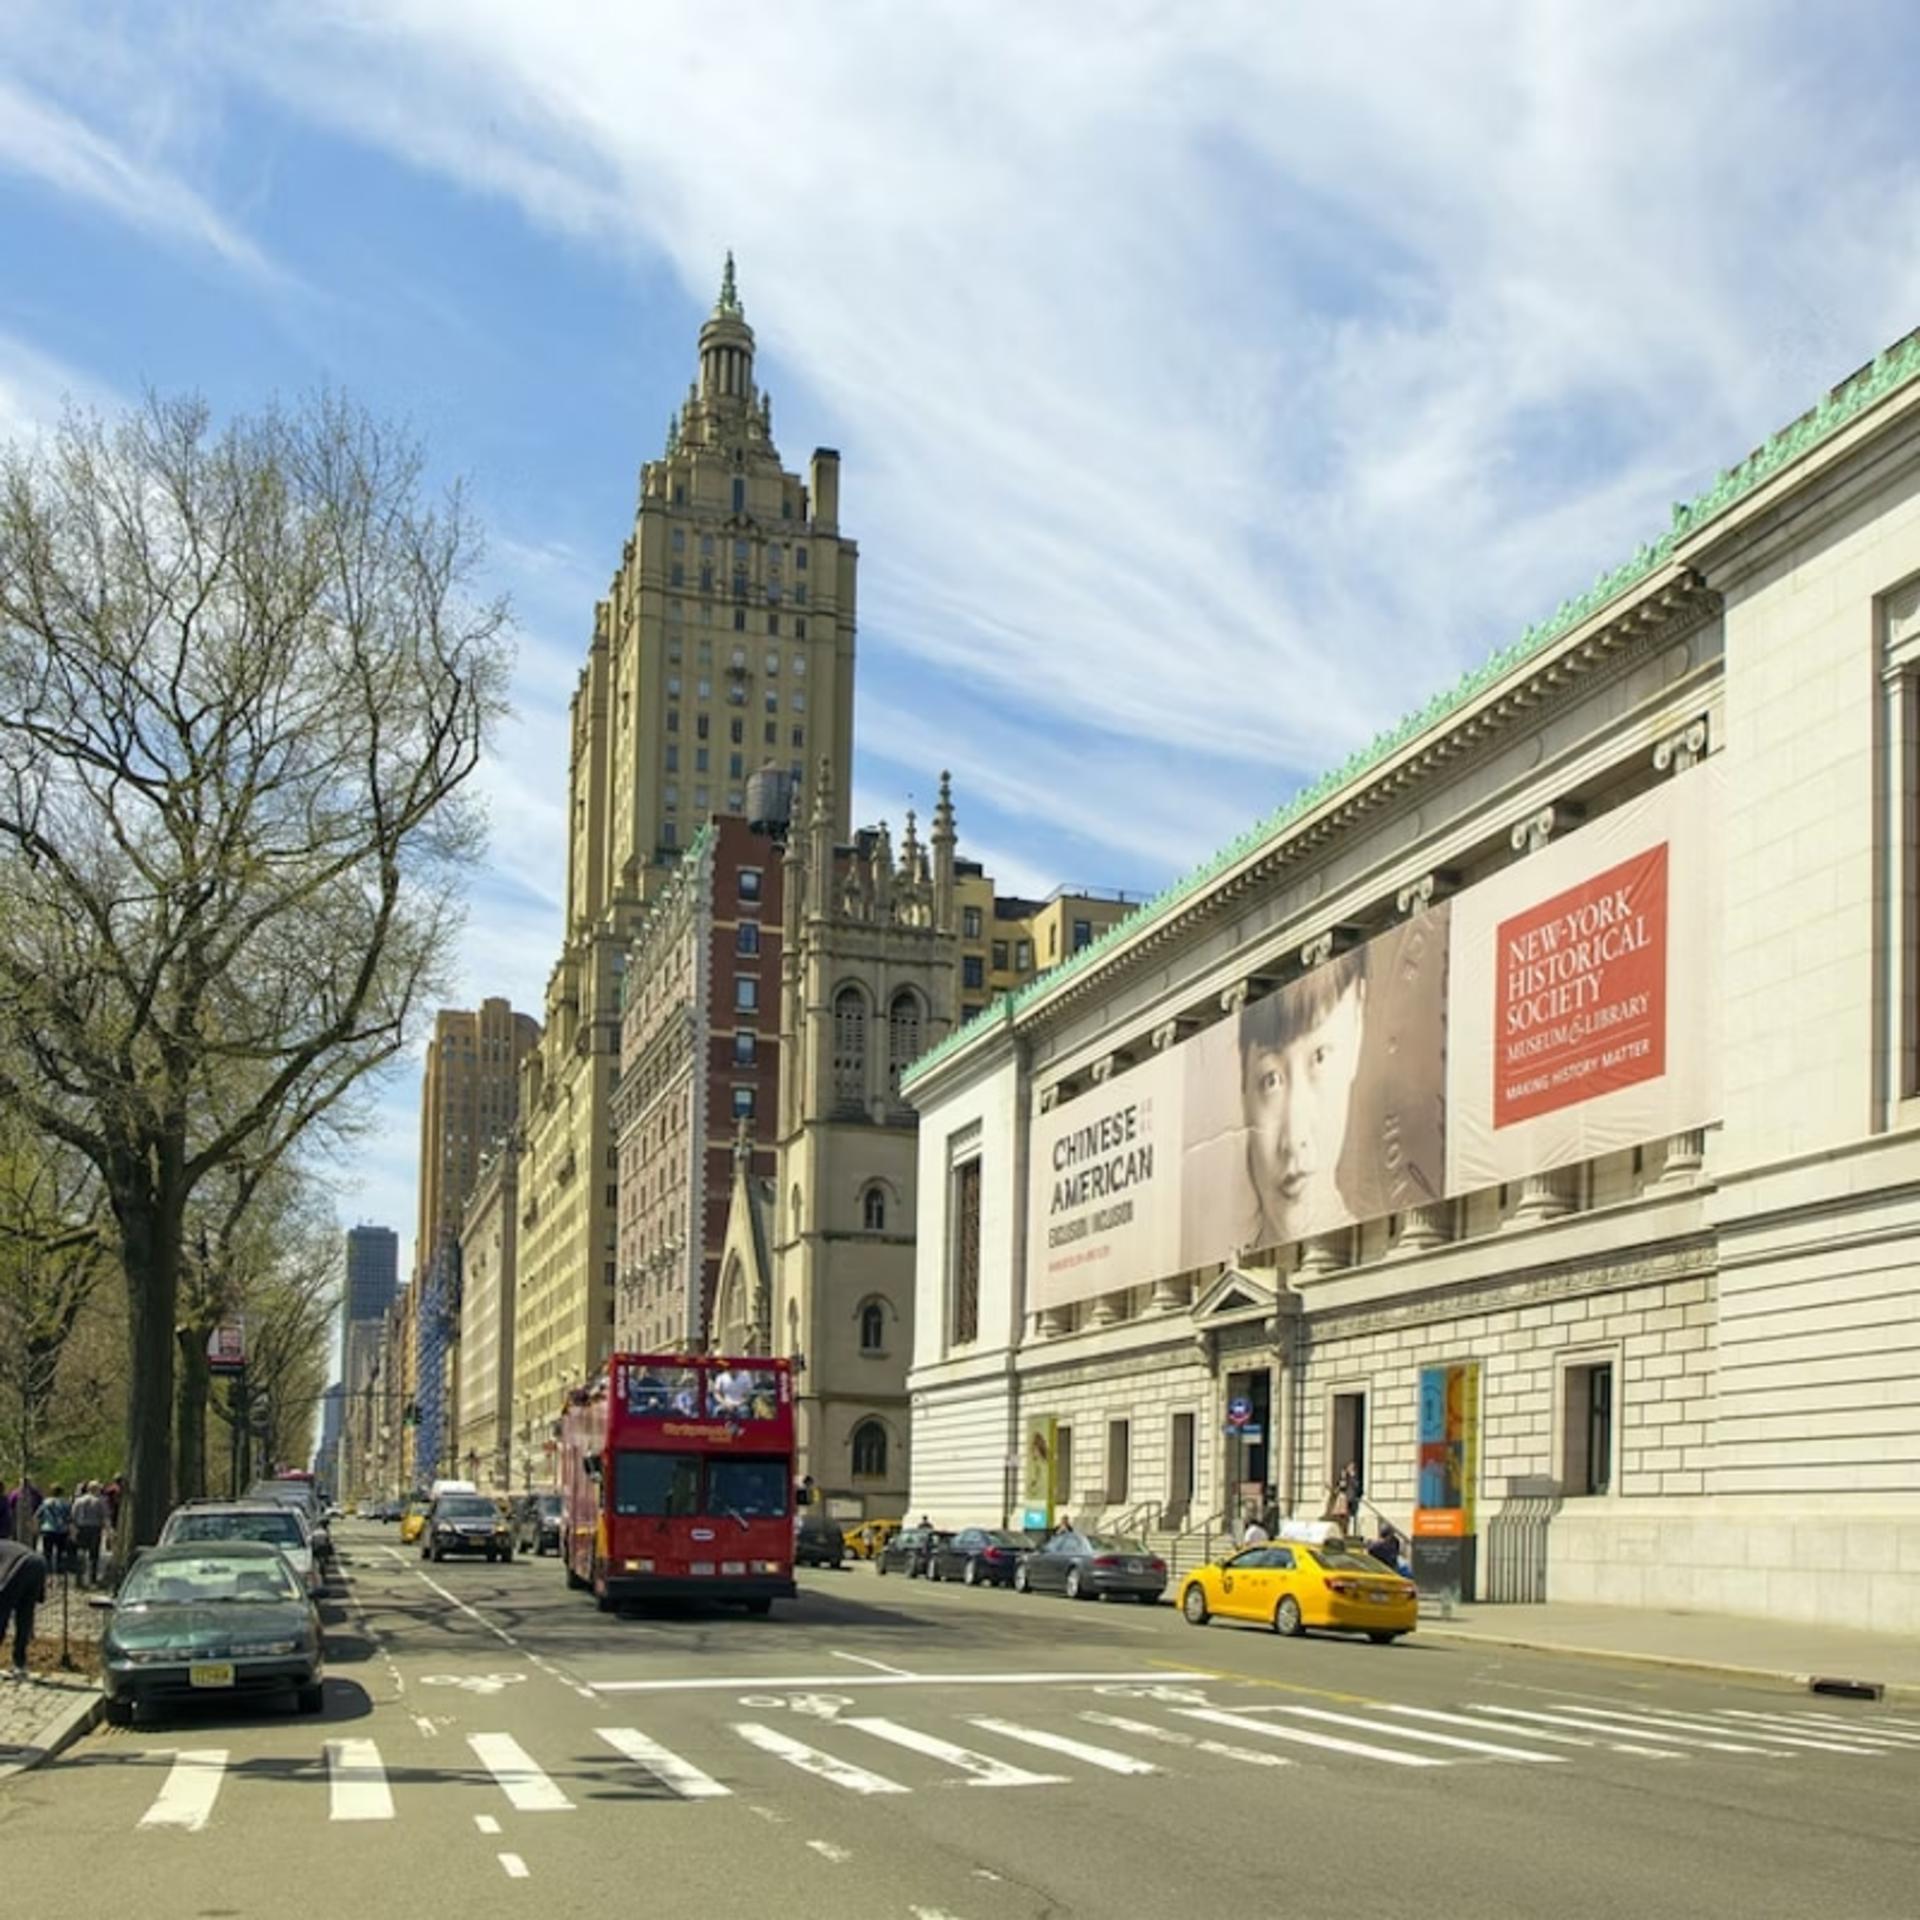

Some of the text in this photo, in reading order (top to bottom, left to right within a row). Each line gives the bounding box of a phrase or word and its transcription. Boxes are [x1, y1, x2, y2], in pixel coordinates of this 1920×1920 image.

[1508, 885, 1633, 969] NEW-YORK
[1508, 916, 1651, 1002] HISTORICAL
[1507, 969, 1604, 1035] SOCIETY
[1507, 1024, 1567, 1063] MUSEUM
[1584, 991, 1651, 1035] LIBRARY
[1601, 1038, 1650, 1068] MATTER
[1053, 1105, 1137, 1172] CHINESE
[1050, 1144, 1153, 1216] AMERICAN
